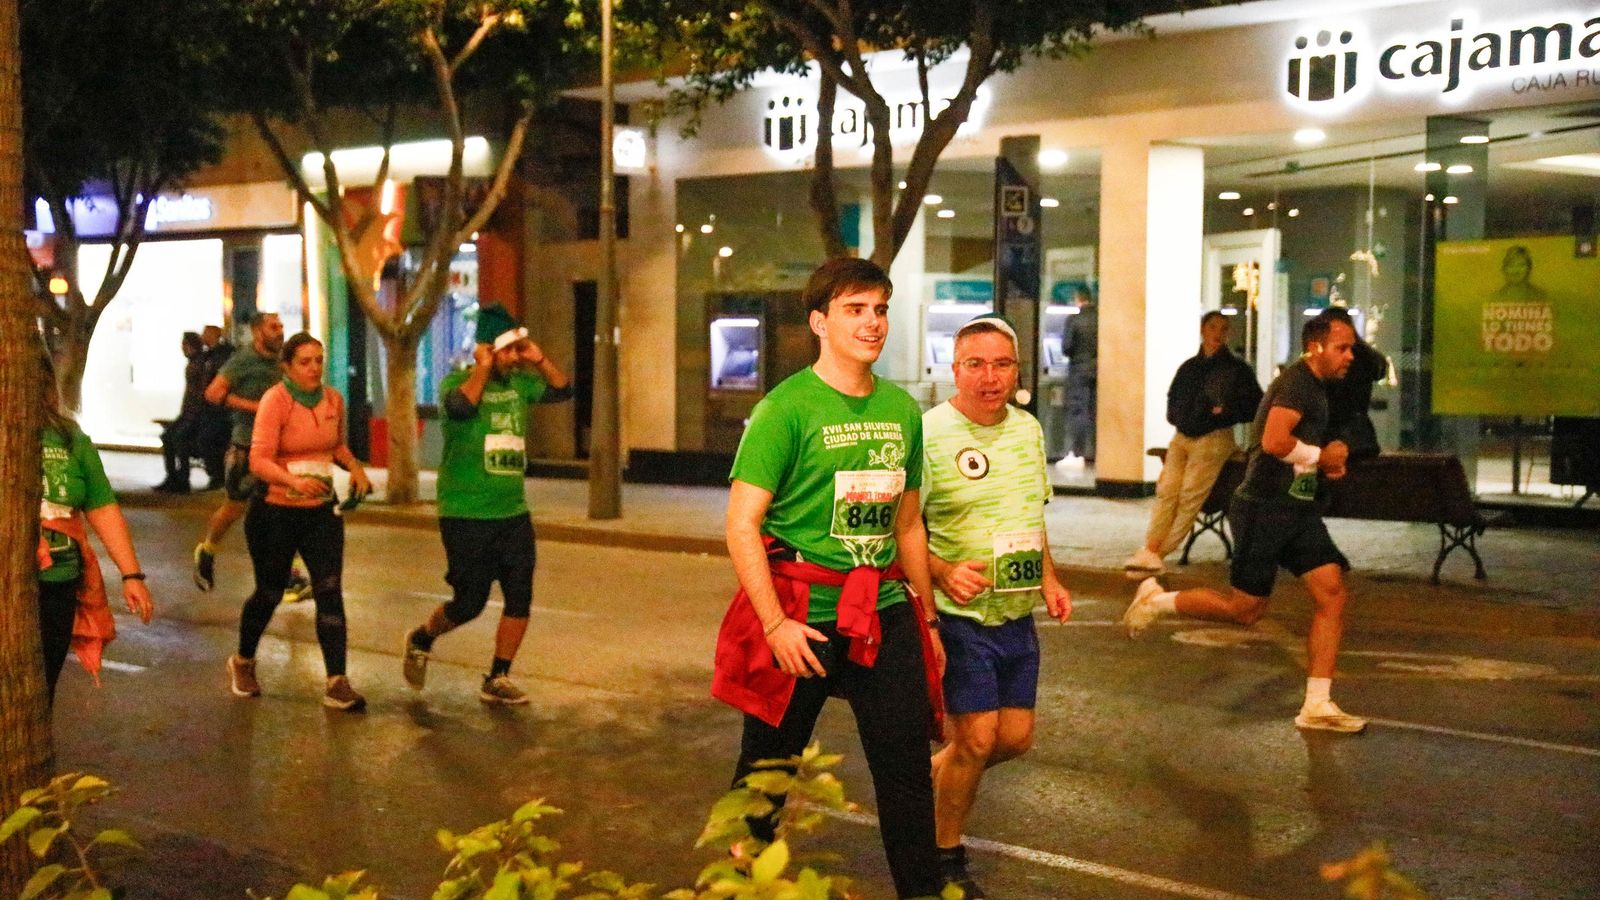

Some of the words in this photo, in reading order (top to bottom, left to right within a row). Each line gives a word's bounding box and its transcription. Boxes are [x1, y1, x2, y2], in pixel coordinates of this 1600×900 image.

[1511, 72, 1567, 94] CAJA
[1484, 332, 1553, 352] TODO
[822, 425, 842, 435] XVII
[844, 422, 862, 432] SAN
[863, 422, 901, 432] SILVESTRE
[823, 432, 859, 444] CIUDAD
[860, 431, 871, 440] DE
[847, 505, 892, 529] 846
